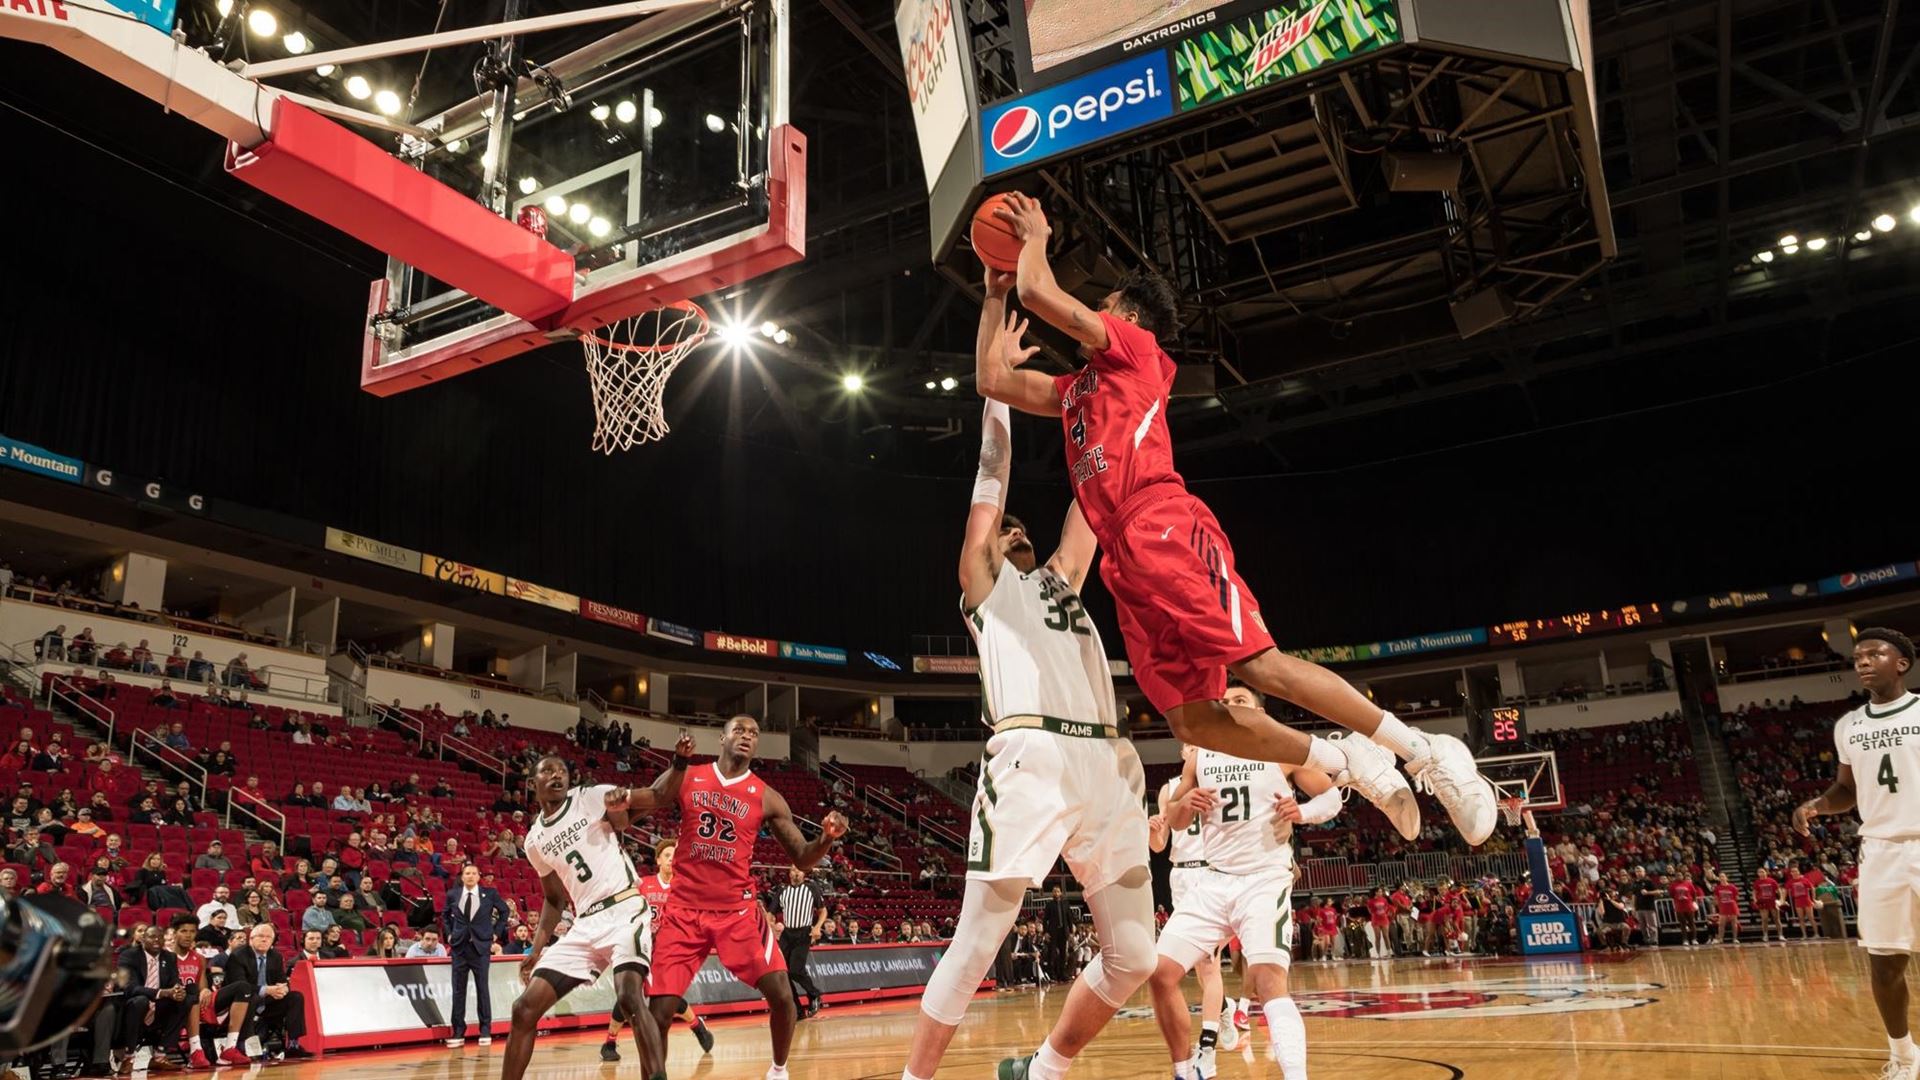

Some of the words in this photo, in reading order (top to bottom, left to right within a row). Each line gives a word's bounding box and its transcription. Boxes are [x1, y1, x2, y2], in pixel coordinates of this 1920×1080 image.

[1123, 11, 1216, 51] DAKTRONICS
[919, 38, 948, 114] LIGHT
[1049, 68, 1155, 139] pepsi
[11, 447, 79, 477] Mountain
[96, 470, 113, 486] G
[145, 482, 161, 498] G
[188, 494, 203, 510] G
[1859, 565, 1898, 585] pepsi
[1040, 592, 1092, 637] 32
[1625, 612, 1641, 626] 69
[172, 633, 189, 648] 122
[1387, 640, 1417, 653] Table
[1420, 632, 1473, 649] Mountain
[1511, 628, 1527, 641] 56
[716, 636, 767, 655] #BeBold
[795, 646, 814, 658] Table
[815, 649, 847, 662] Mountain
[1060, 722, 1092, 736] RAMS
[1494, 720, 1518, 741] 25
[1849, 726, 1920, 745] COLORADO
[1862, 736, 1903, 751] STATE
[1203, 762, 1265, 776] COLORADO
[1215, 772, 1251, 783] STATE
[1877, 753, 1899, 794] 4
[691, 790, 750, 819] FRESNO
[1220, 786, 1251, 823] 21
[541, 818, 588, 855] COLORADO
[697, 811, 738, 843] 32
[551, 835, 581, 857] STATE
[690, 843, 736, 864] STATE
[565, 849, 593, 884] 3
[1531, 922, 1565, 935] BUD
[1526, 932, 1573, 946] LIGHT
[816, 960, 869, 977] REGARDLESS
[870, 960, 882, 973] OF
